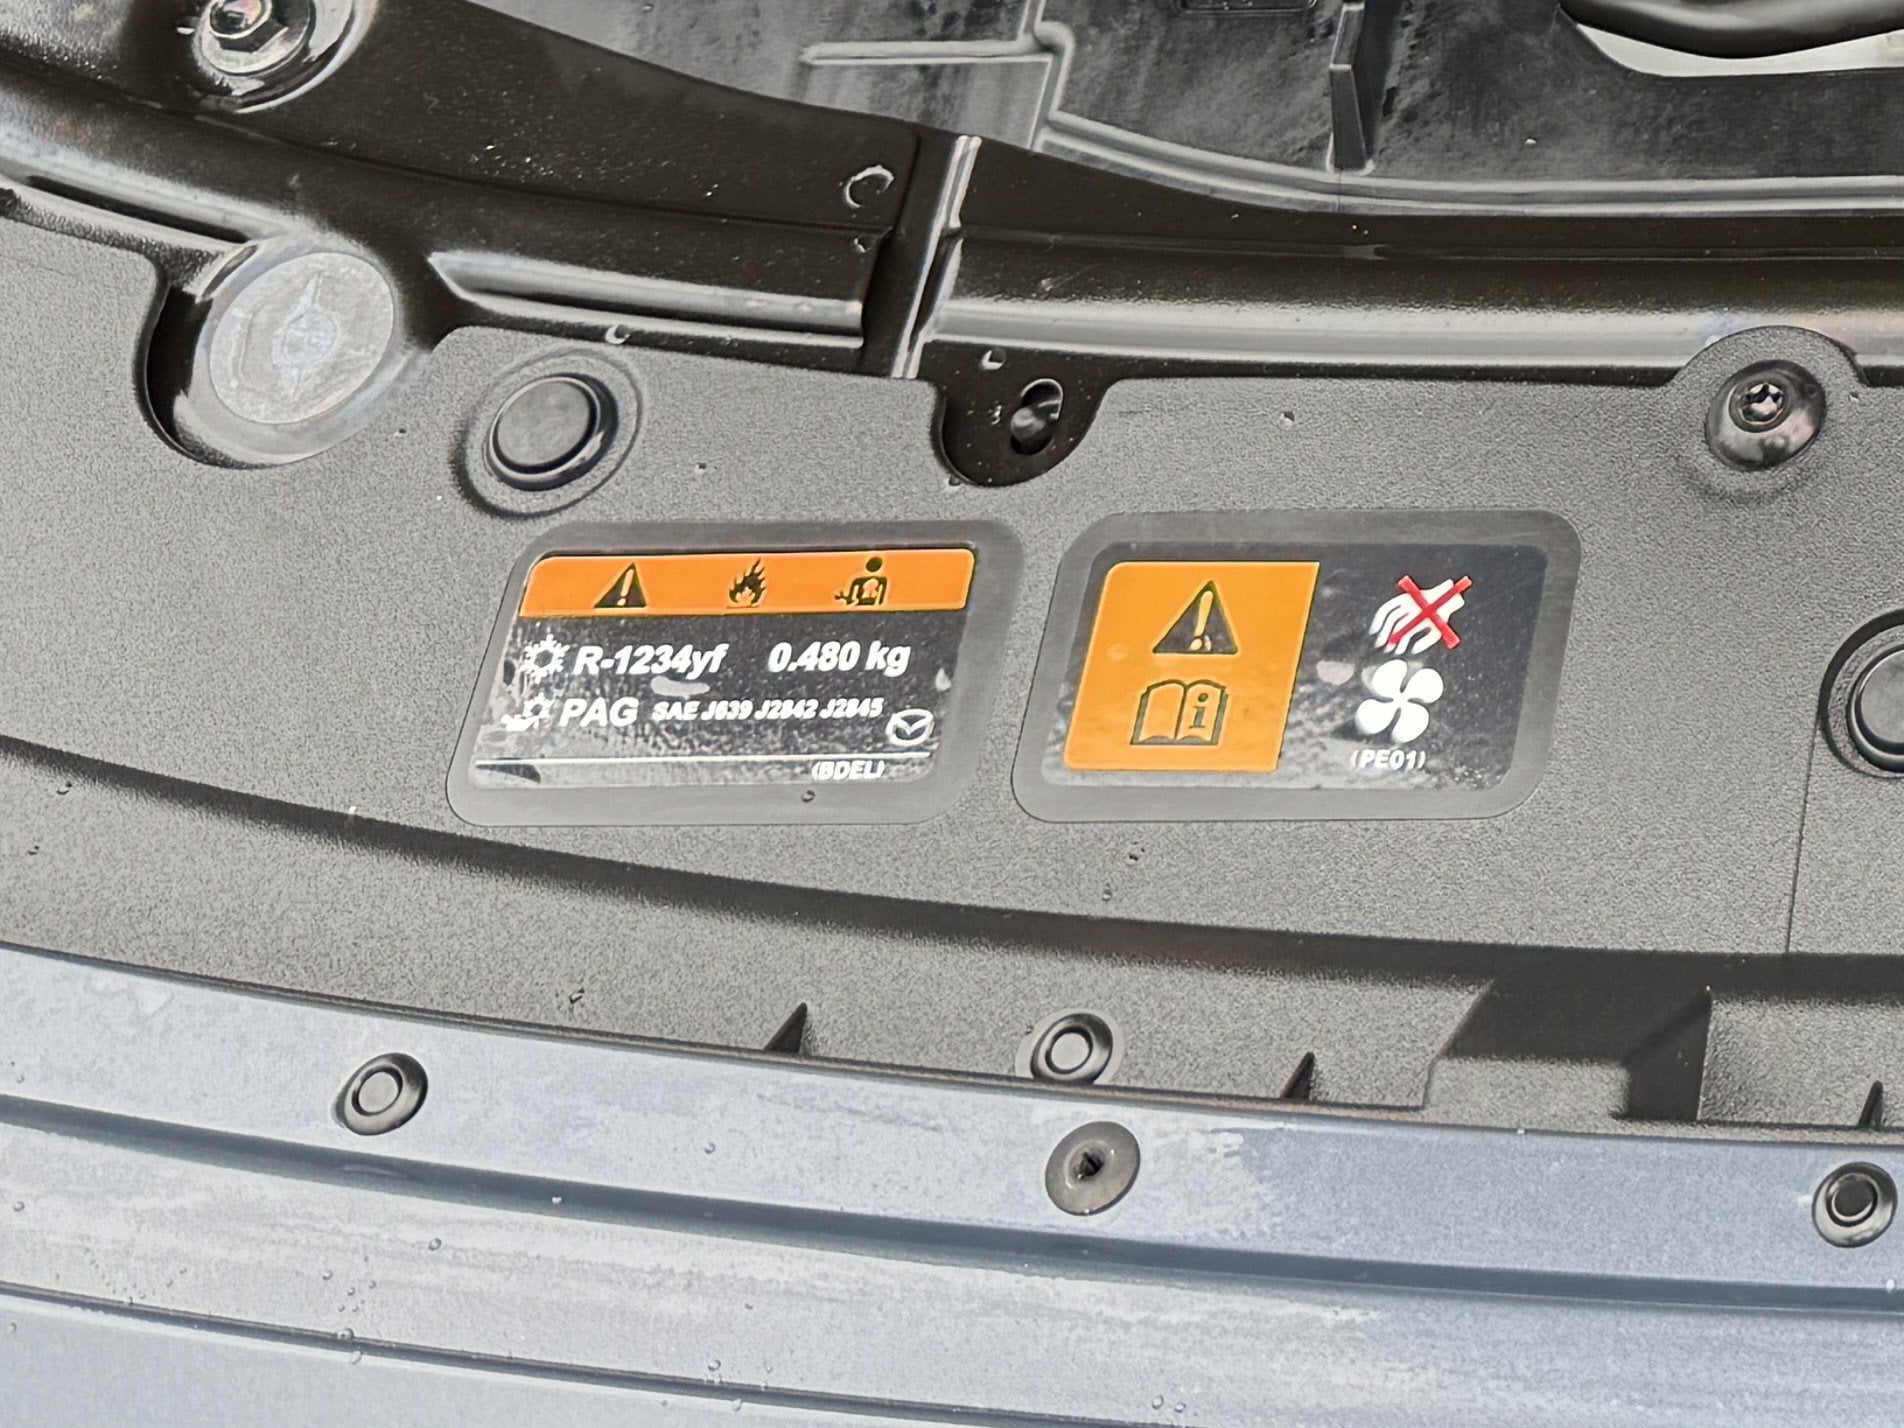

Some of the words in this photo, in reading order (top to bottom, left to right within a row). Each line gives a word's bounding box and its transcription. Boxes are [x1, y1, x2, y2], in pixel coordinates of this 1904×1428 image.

[572, 643, 730, 679] R-1234yf
[767, 642, 859, 673] 0.480
[864, 641, 911, 677] kg
[559, 698, 638, 727] PAG
[651, 699, 700, 720] SAE
[701, 699, 752, 720] J639
[1350, 748, 1427, 771] (PE01)
